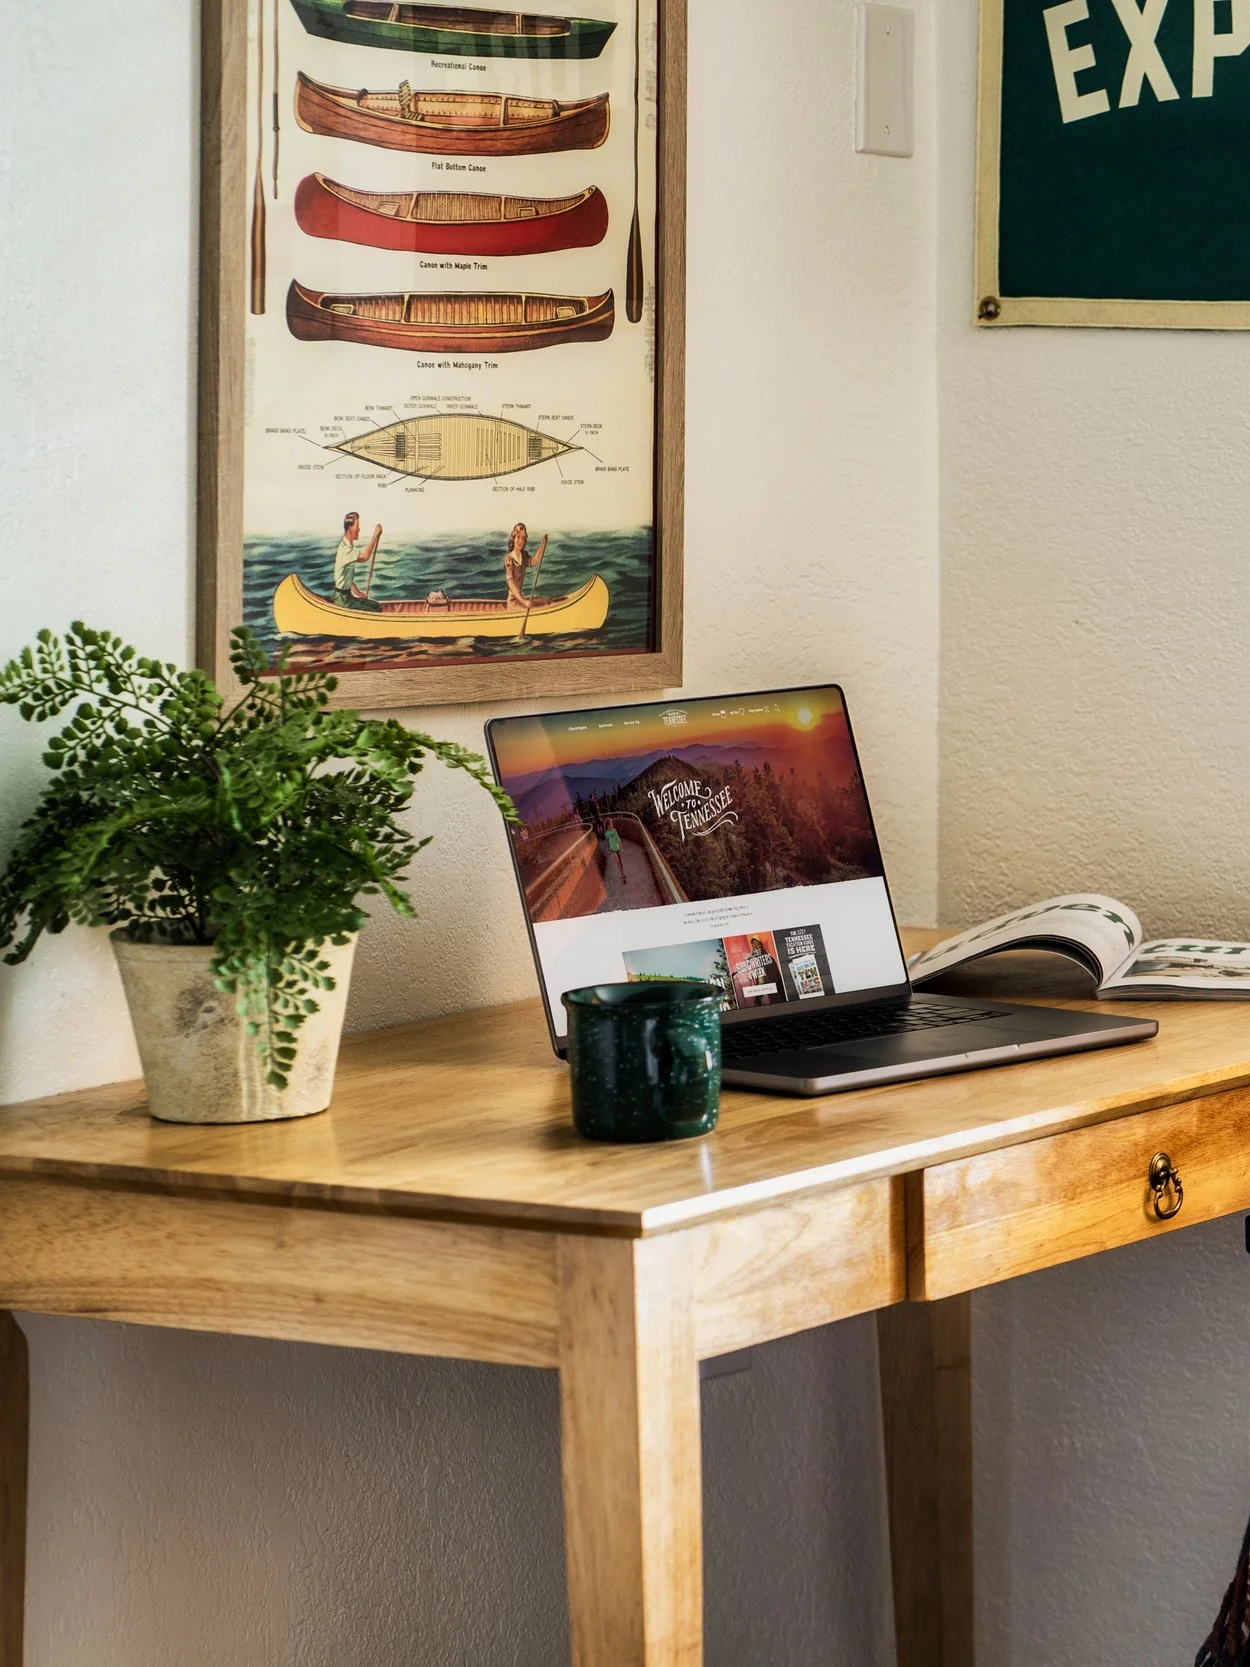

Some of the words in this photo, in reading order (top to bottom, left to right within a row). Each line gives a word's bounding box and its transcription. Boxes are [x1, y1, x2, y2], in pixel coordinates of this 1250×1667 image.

[431, 60, 466, 70] Recreational
[468, 61, 487, 72] Canoe
[431, 161, 443, 170] Flat
[445, 162, 466, 171] Bottom
[468, 163, 486, 172] Canoe
[419, 260, 438, 269] Canoe
[440, 261, 453, 269] with
[454, 262, 472, 271] Maple
[473, 262, 488, 270] Trim
[416, 360, 435, 368] Canoe
[437, 361, 451, 369] with
[452, 361, 482, 371] Mahogany
[484, 361, 499, 369] Trim
[647, 779, 712, 818] WELCOME
[685, 799, 697, 809] TO
[670, 785, 733, 842] TENNESSEE
[784, 934, 814, 944] TENNESSEE
[787, 947, 797, 956] IS
[796, 944, 816, 954] HERE
